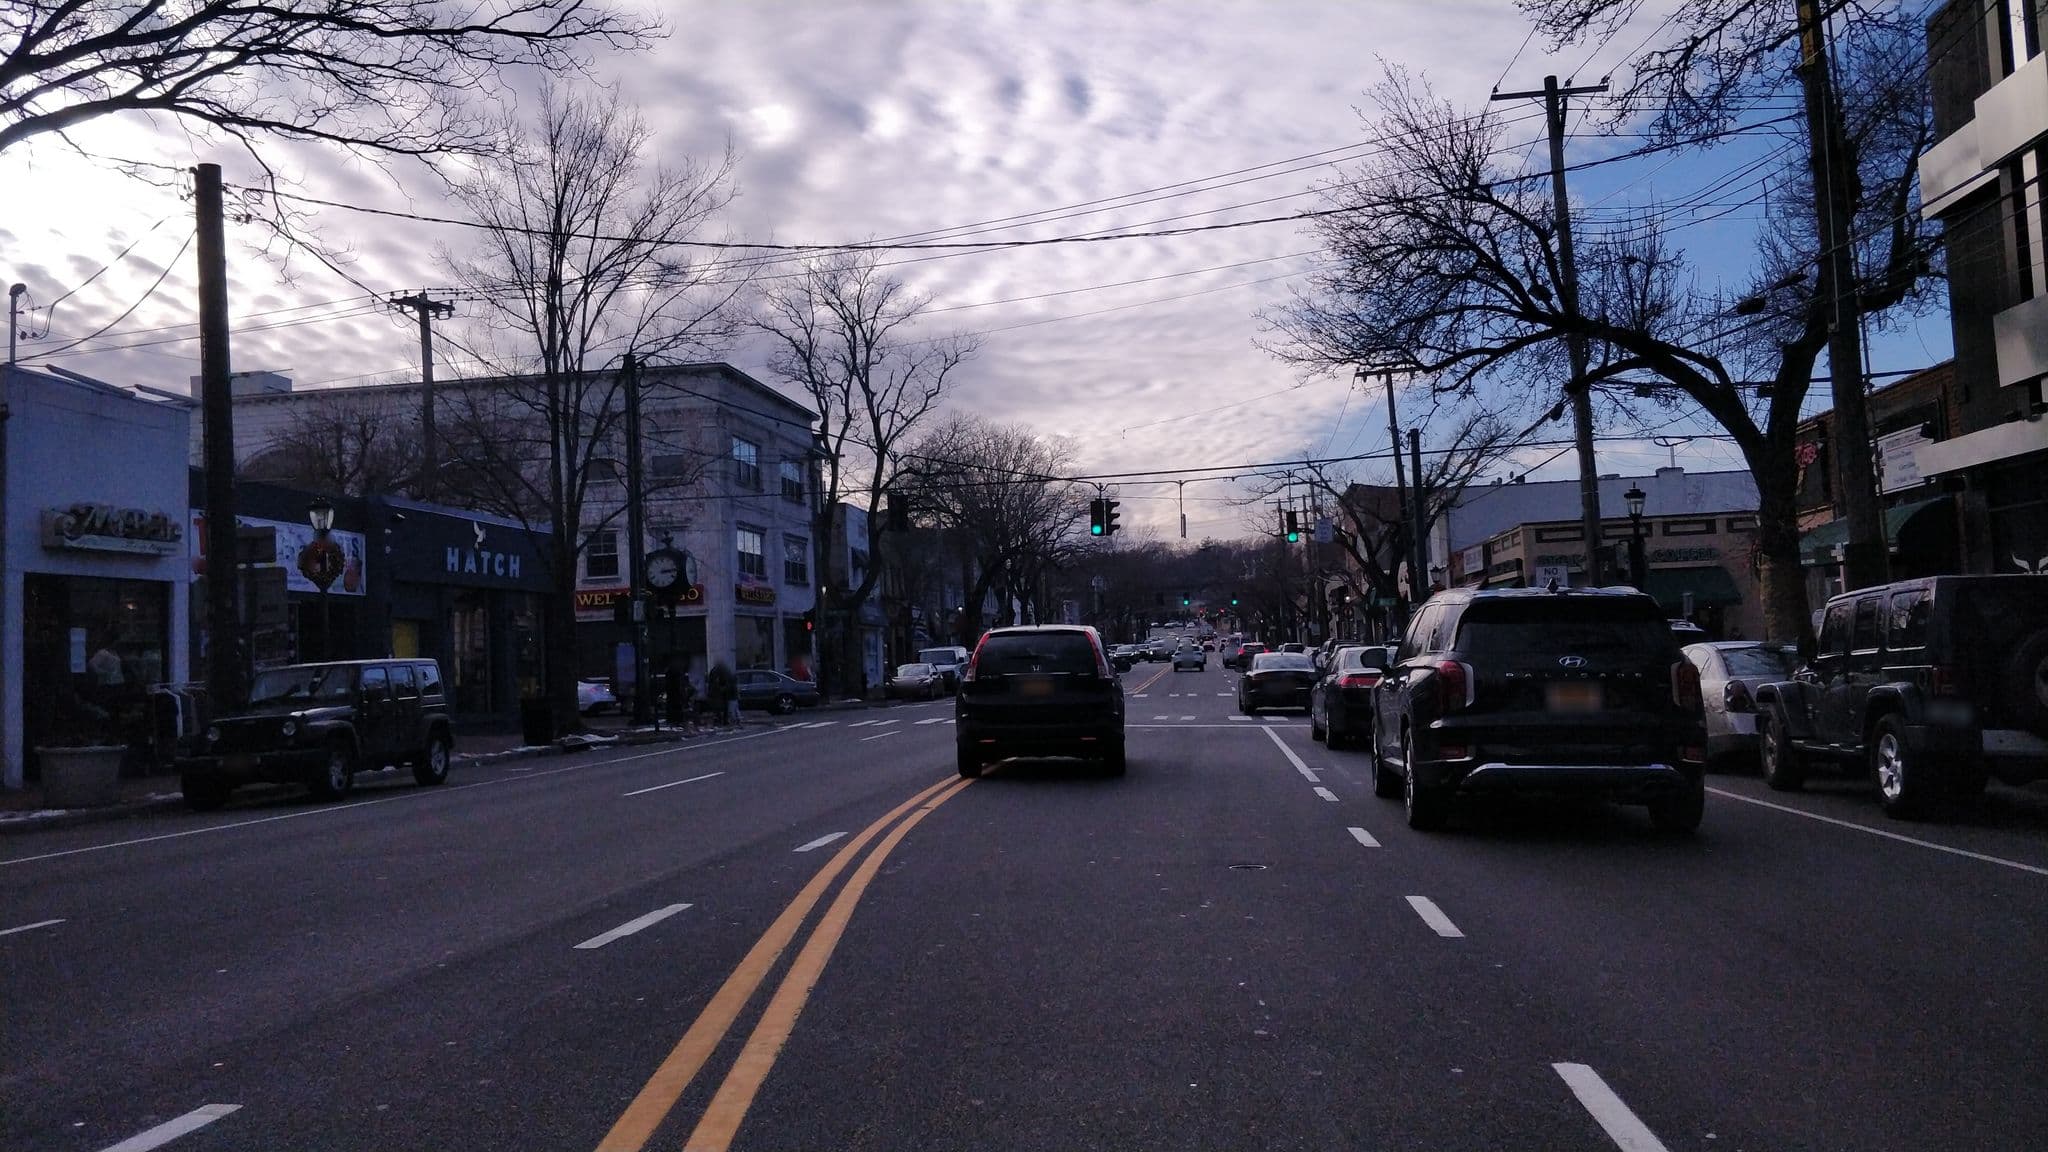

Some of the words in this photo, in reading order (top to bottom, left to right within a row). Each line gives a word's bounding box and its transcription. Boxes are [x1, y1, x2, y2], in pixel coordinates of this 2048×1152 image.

[447, 547, 520, 578] HATCH
[1544, 567, 1558, 576] NO
[577, 591, 632, 606] WEL
